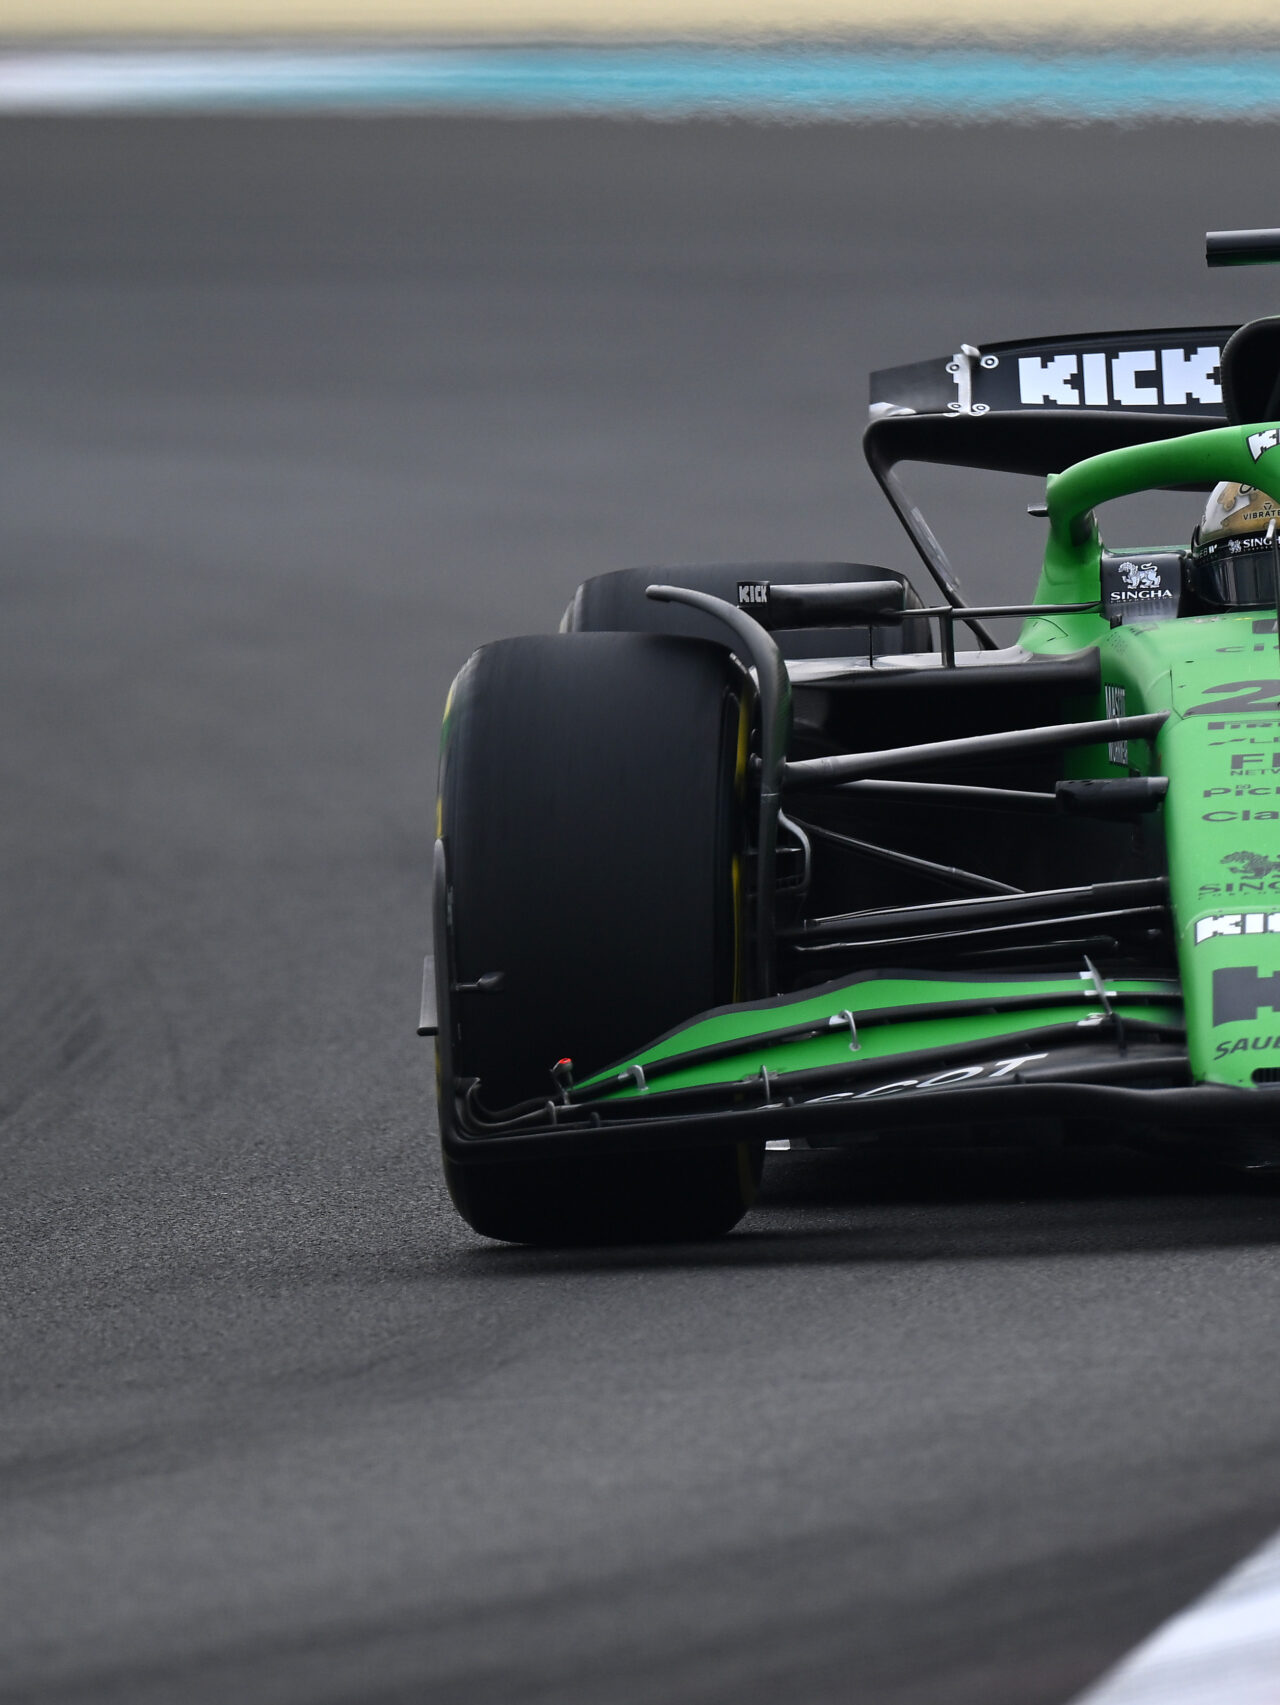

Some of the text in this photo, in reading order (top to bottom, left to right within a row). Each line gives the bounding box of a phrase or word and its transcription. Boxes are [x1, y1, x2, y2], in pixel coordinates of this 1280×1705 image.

[1018, 346, 1222, 405] KICK
[739, 585, 767, 603] KICK
[1110, 589, 1173, 601] SINGHA
